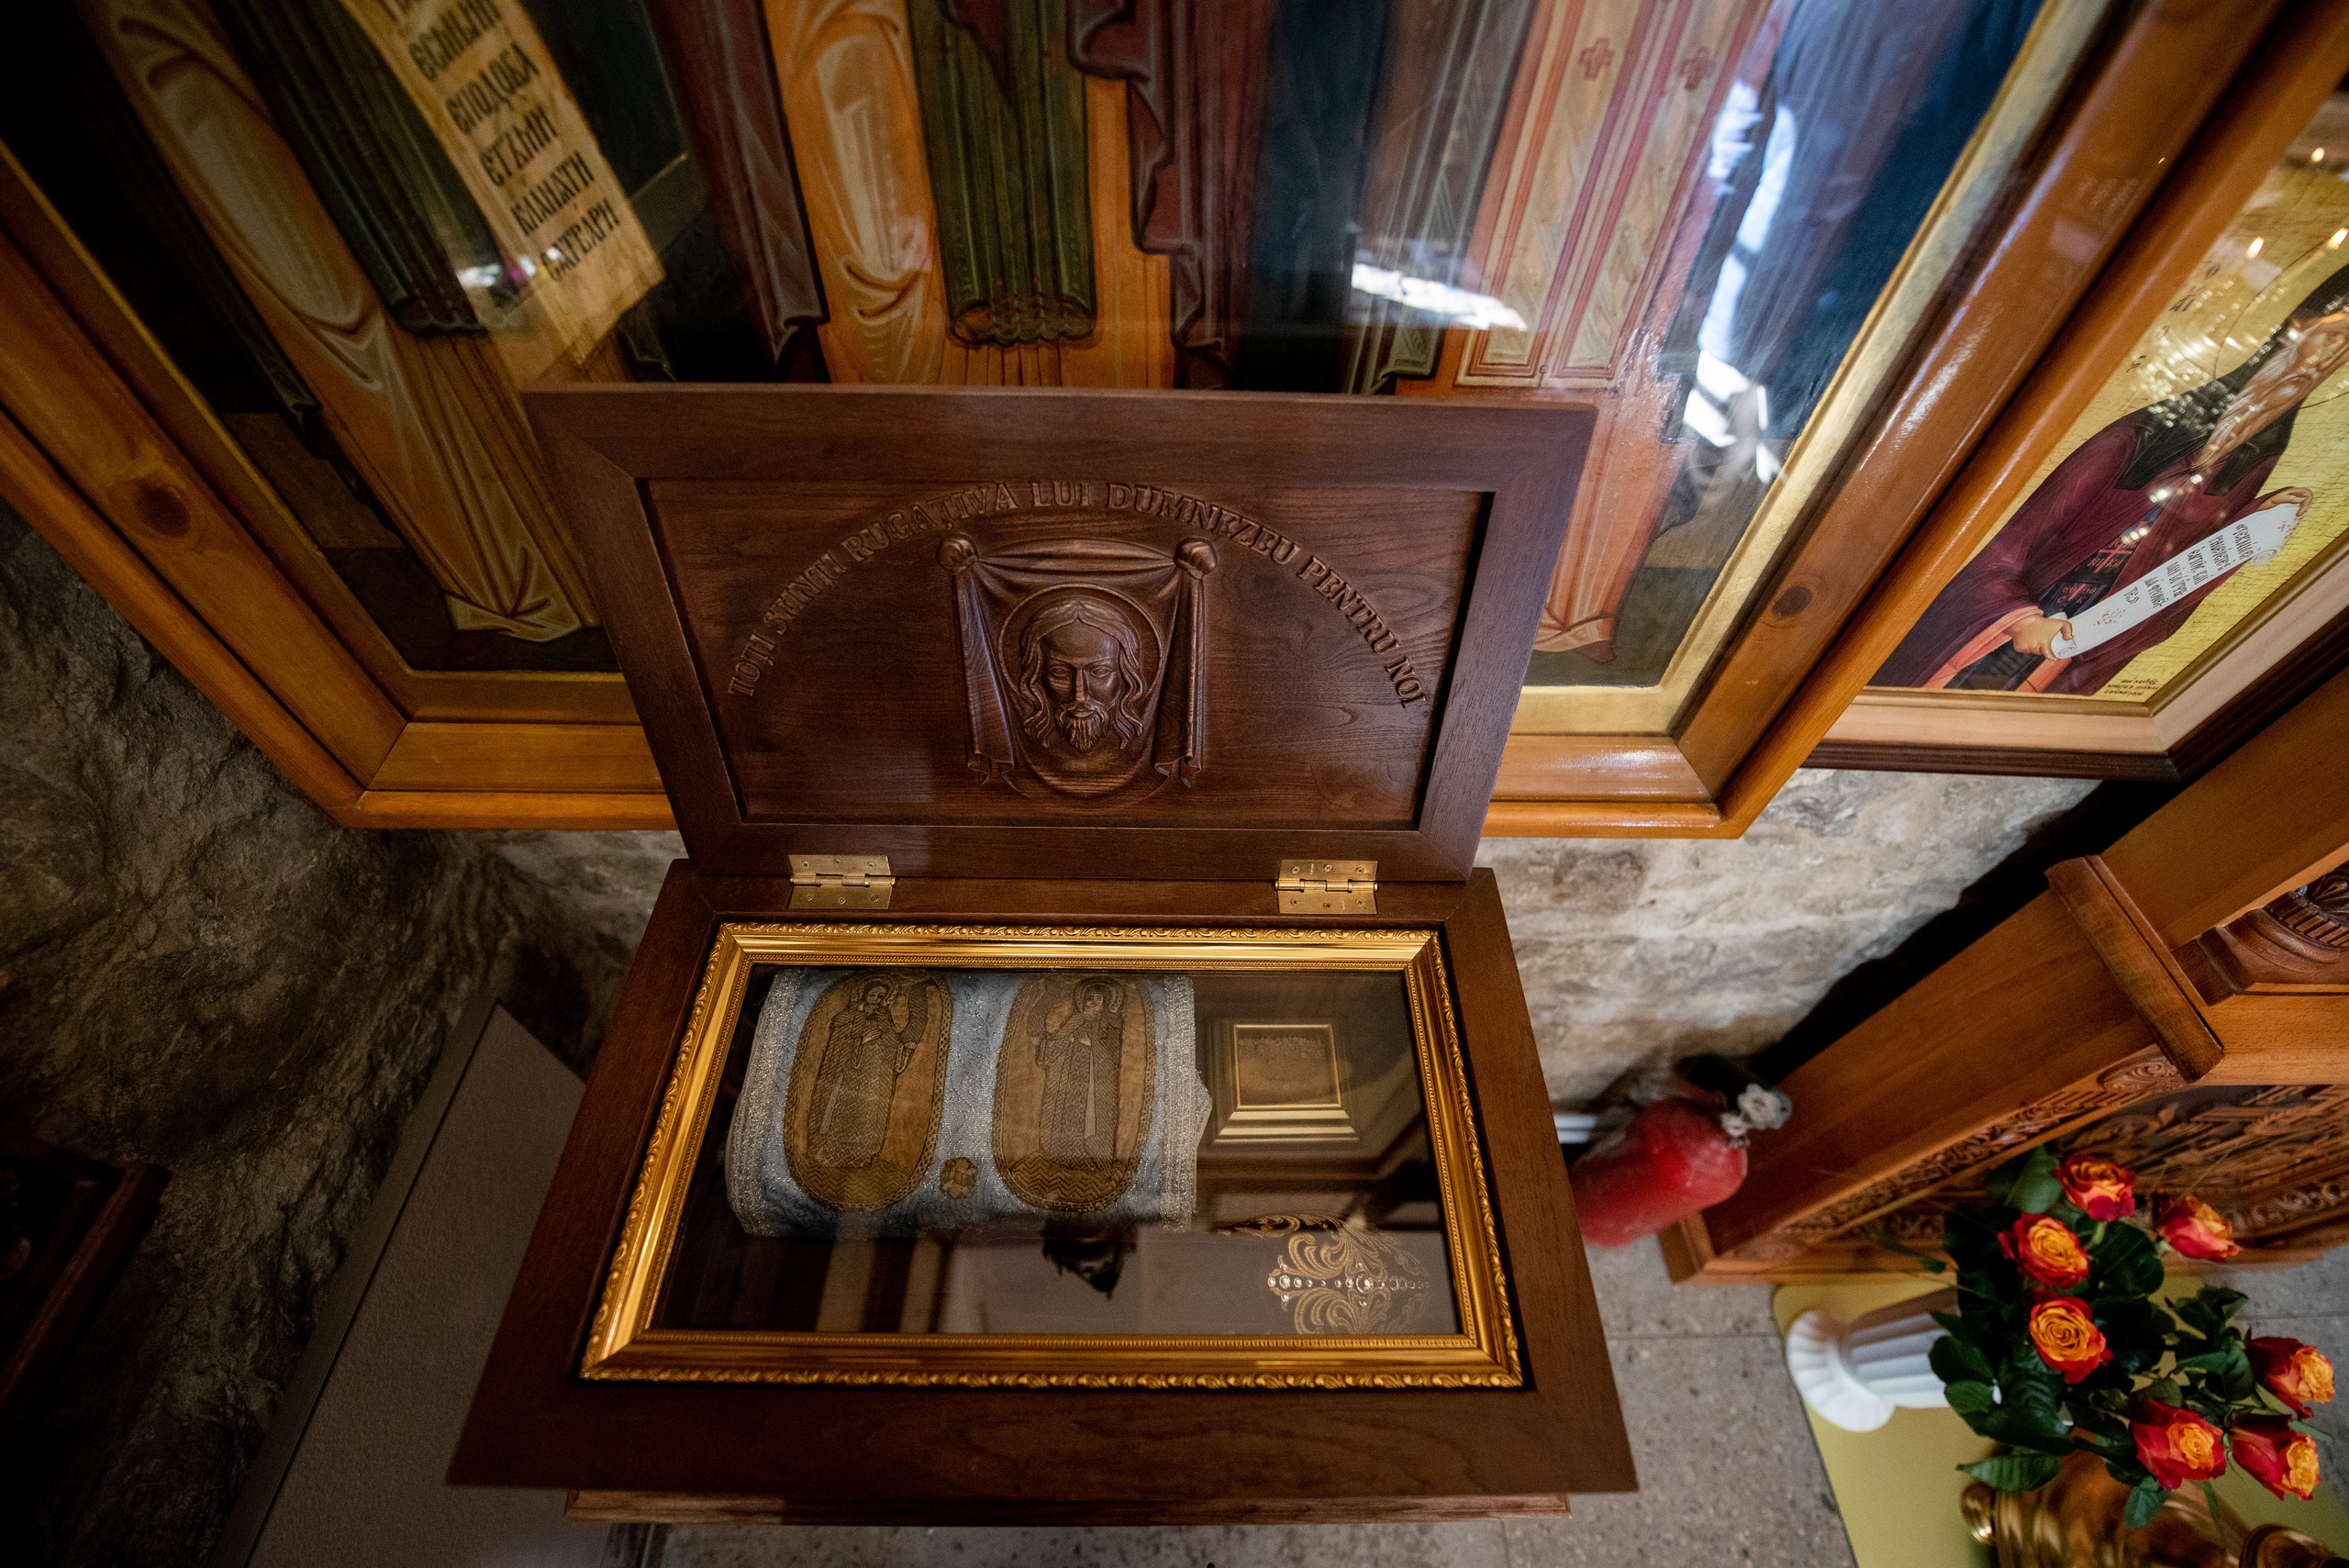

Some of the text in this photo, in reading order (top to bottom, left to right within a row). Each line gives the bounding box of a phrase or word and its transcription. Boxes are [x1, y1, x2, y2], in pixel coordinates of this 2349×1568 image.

[1030, 481, 1090, 507] LUI
[1105, 483, 1301, 565] DUMNEZEU
[1297, 555, 1402, 654] PENTRU
[1385, 656, 1427, 709] NOI
